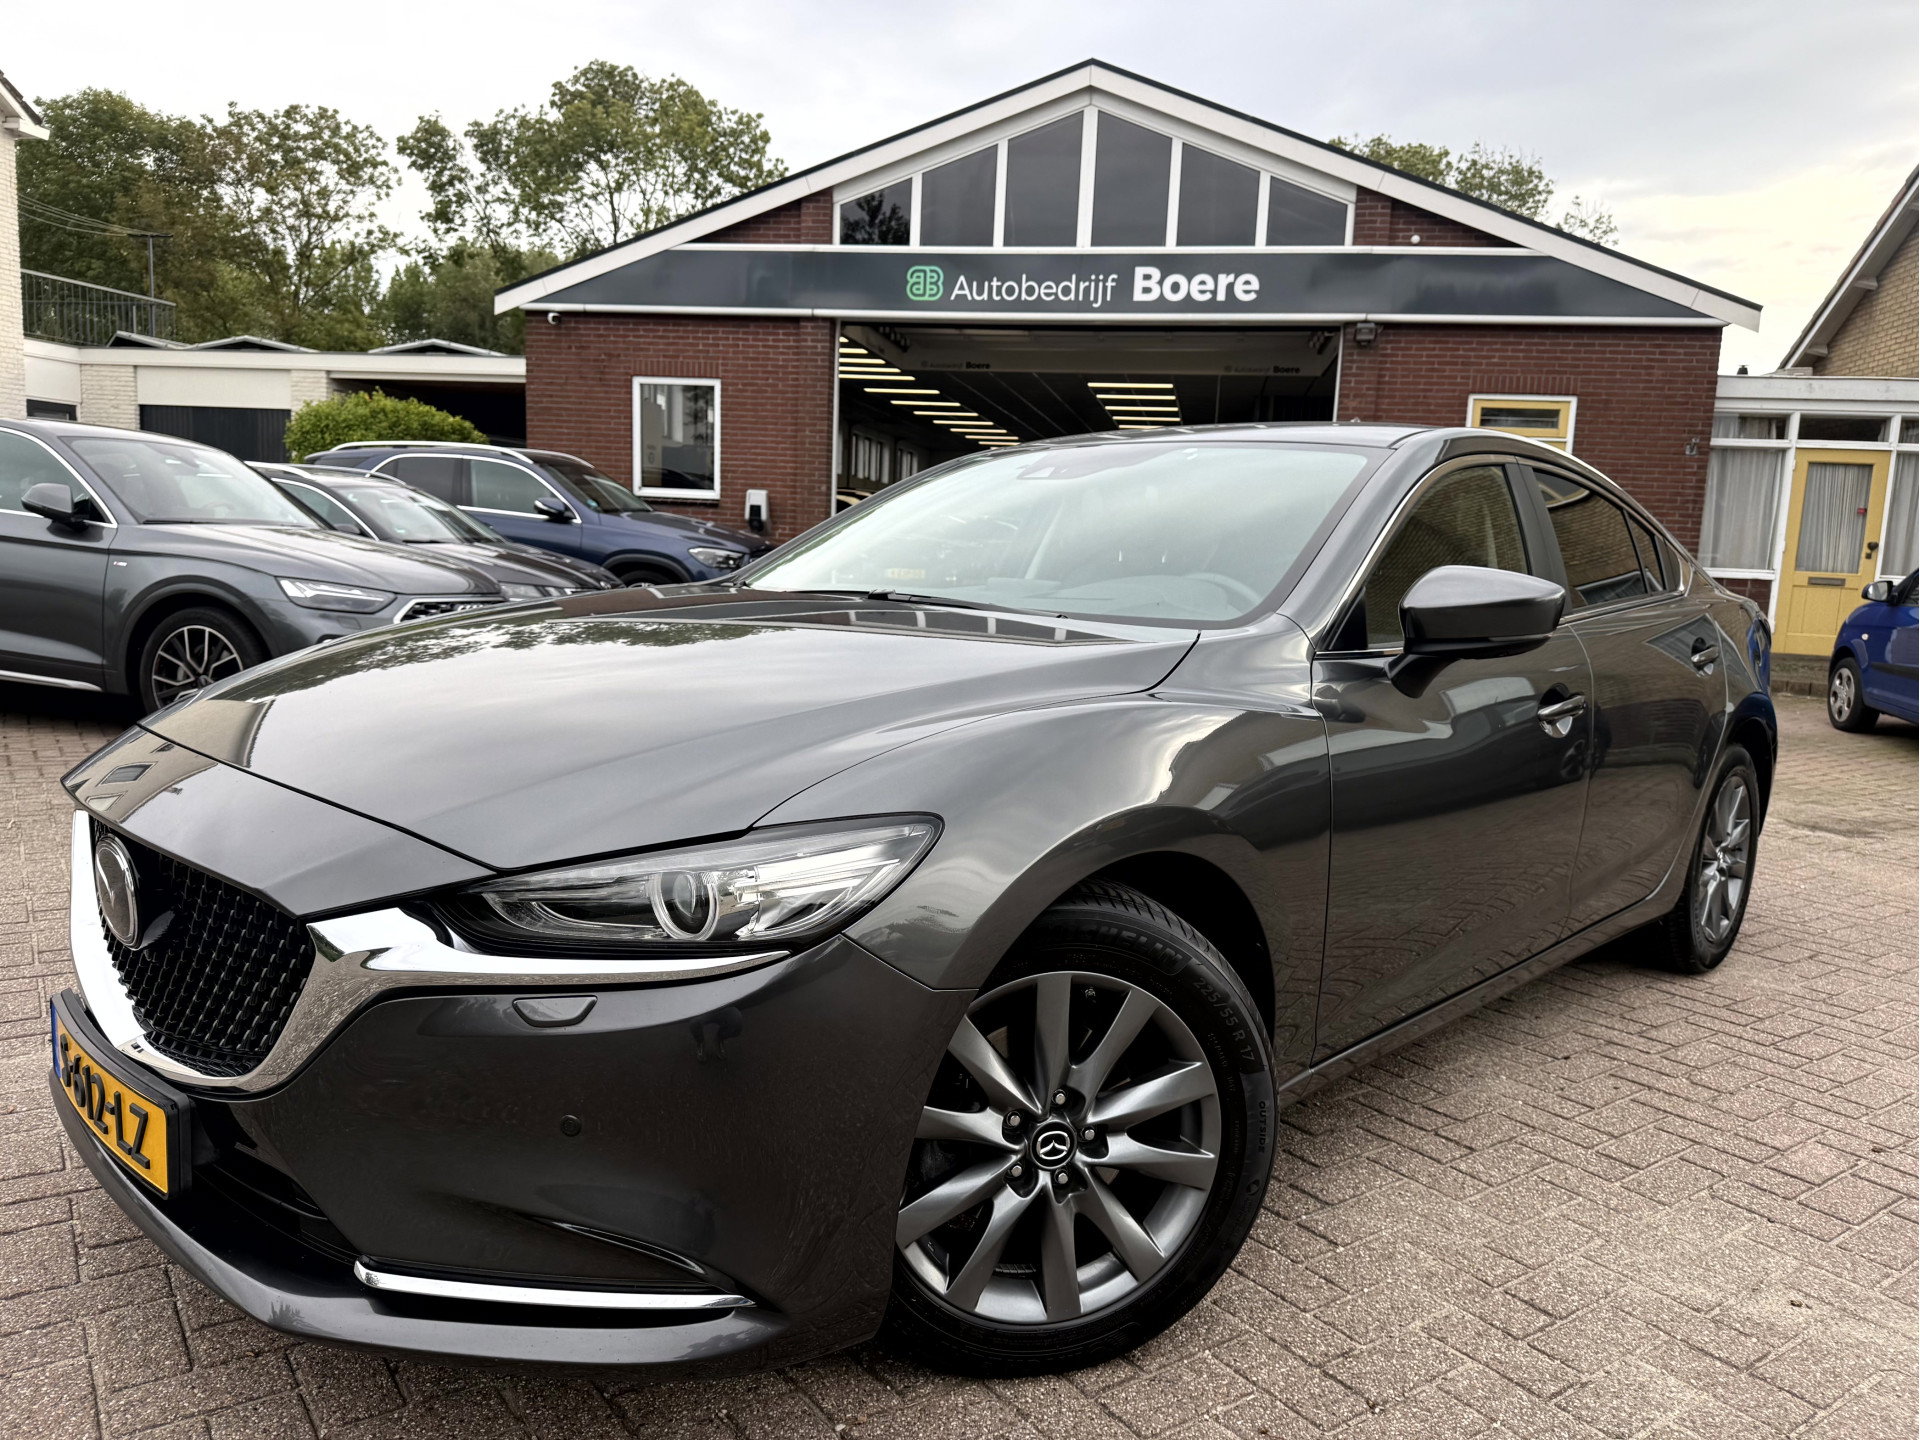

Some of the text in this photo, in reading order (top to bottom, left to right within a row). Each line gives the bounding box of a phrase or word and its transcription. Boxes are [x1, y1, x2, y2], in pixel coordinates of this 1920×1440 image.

[950, 273, 1119, 308] Autobedrijf
[1132, 266, 1260, 302] Boere
[965, 360, 991, 370] Boere
[1272, 365, 1301, 375] Boere
[1193, 977, 1239, 1026] 225/55
[1232, 1029, 1246, 1042] R
[1240, 1044, 1256, 1061] 17
